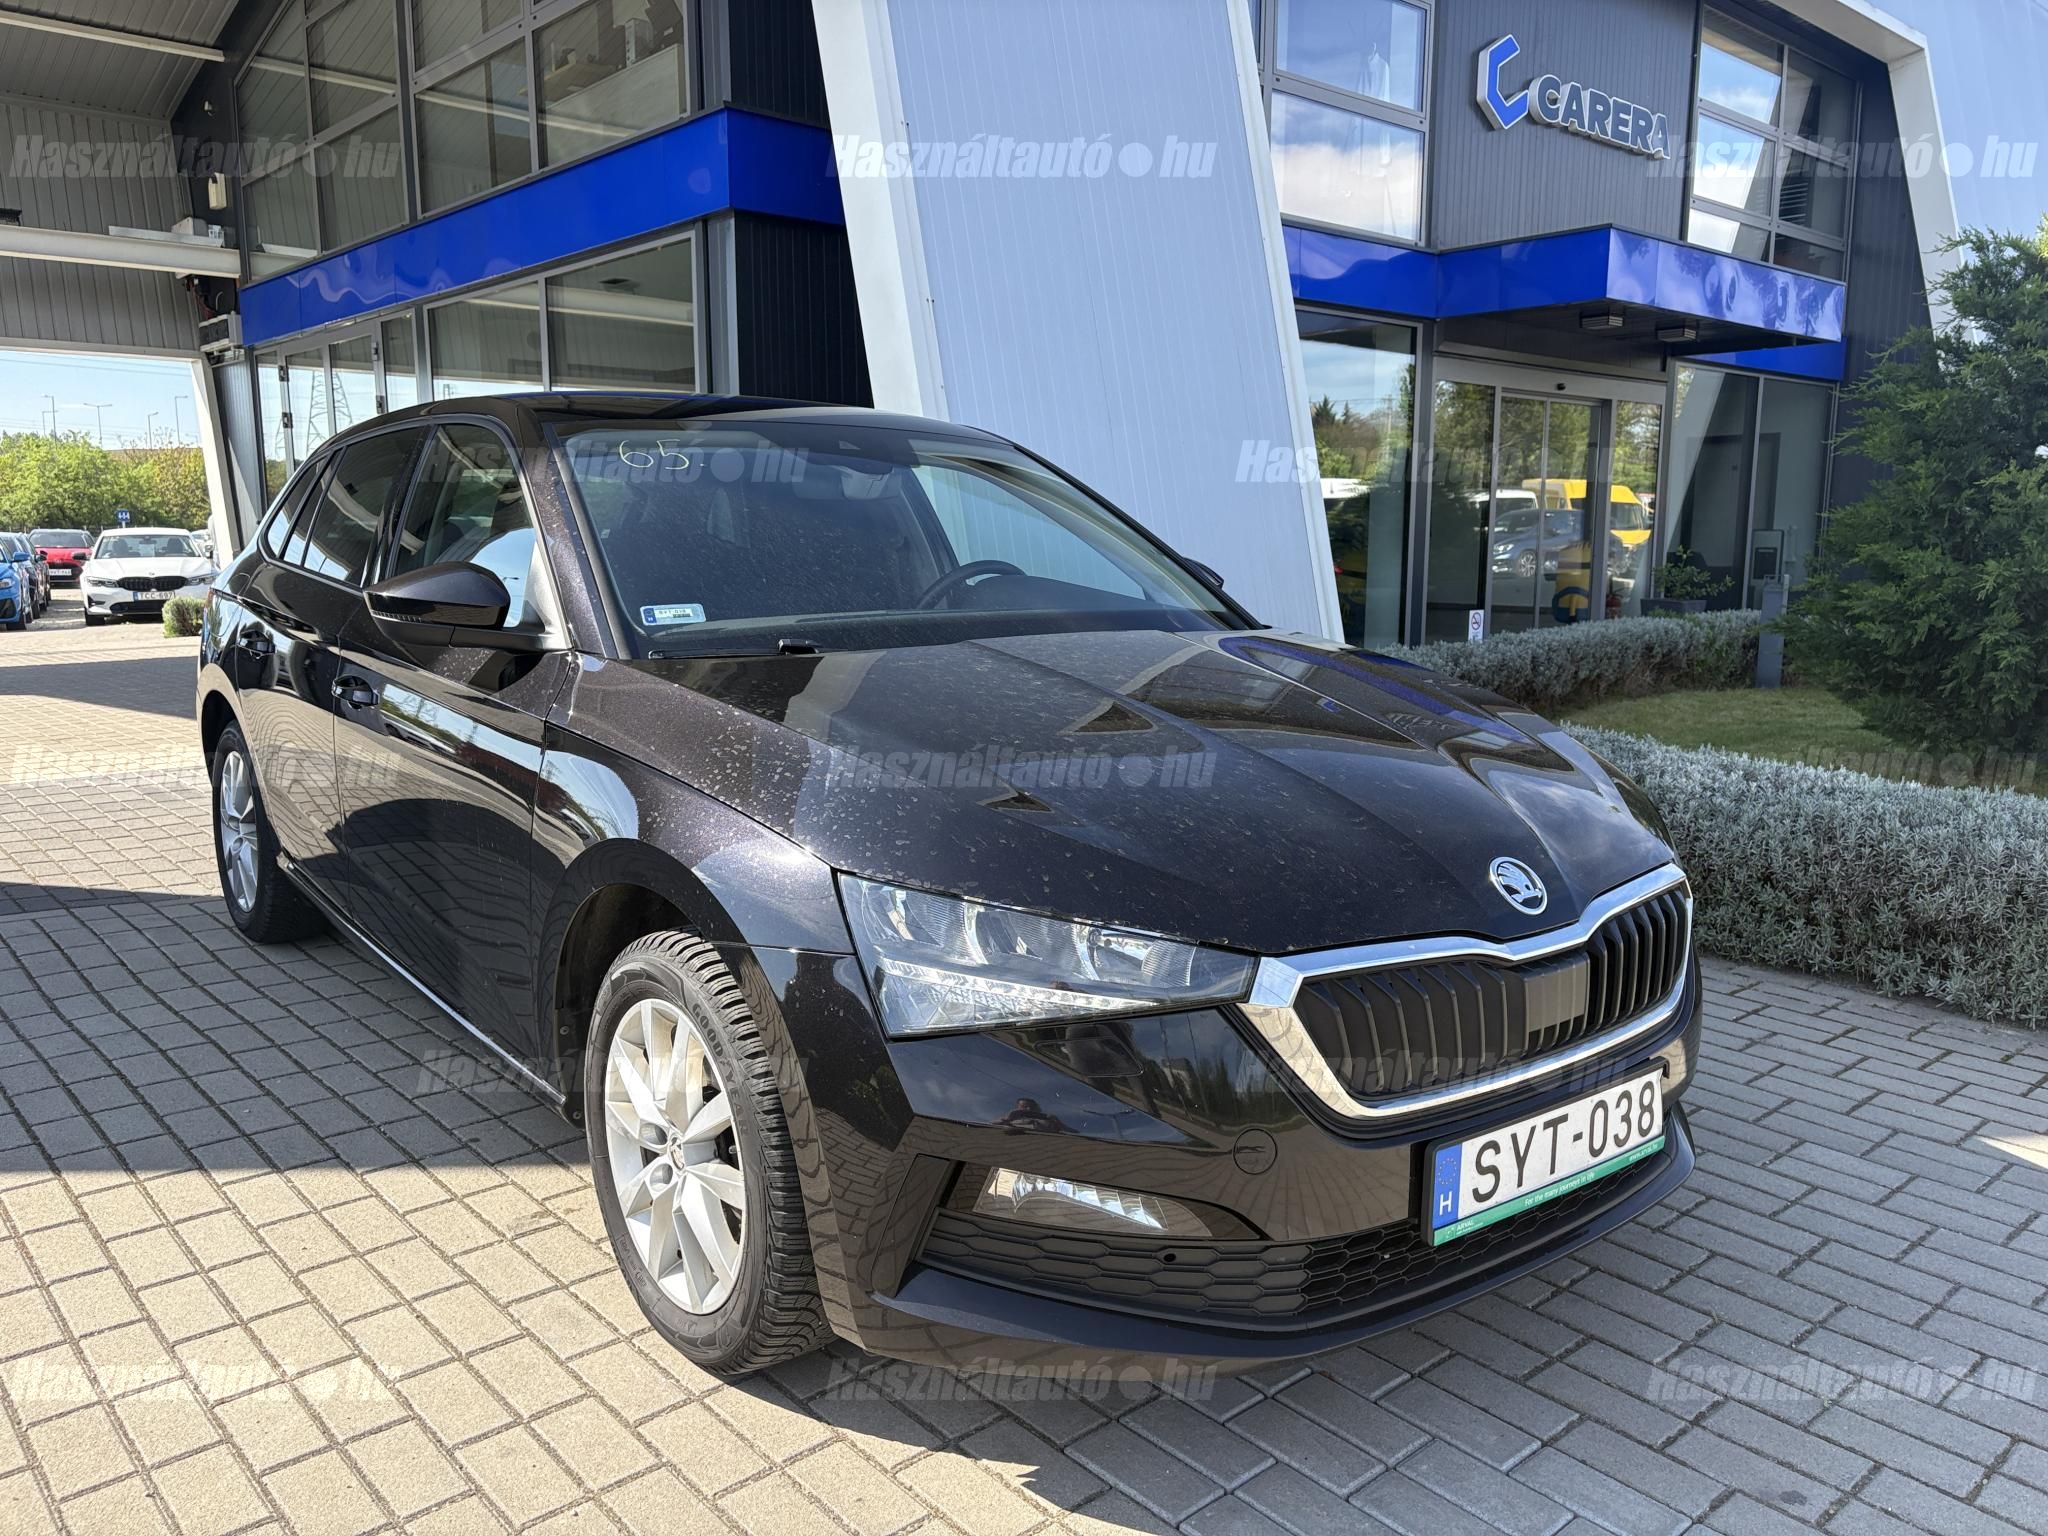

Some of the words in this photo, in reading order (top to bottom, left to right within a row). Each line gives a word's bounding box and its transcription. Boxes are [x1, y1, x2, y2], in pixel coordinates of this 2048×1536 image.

[1529, 74, 1670, 160] CARERA
[1472, 1080, 1655, 1203] SYT-038
[1439, 1191, 1452, 1216] H
